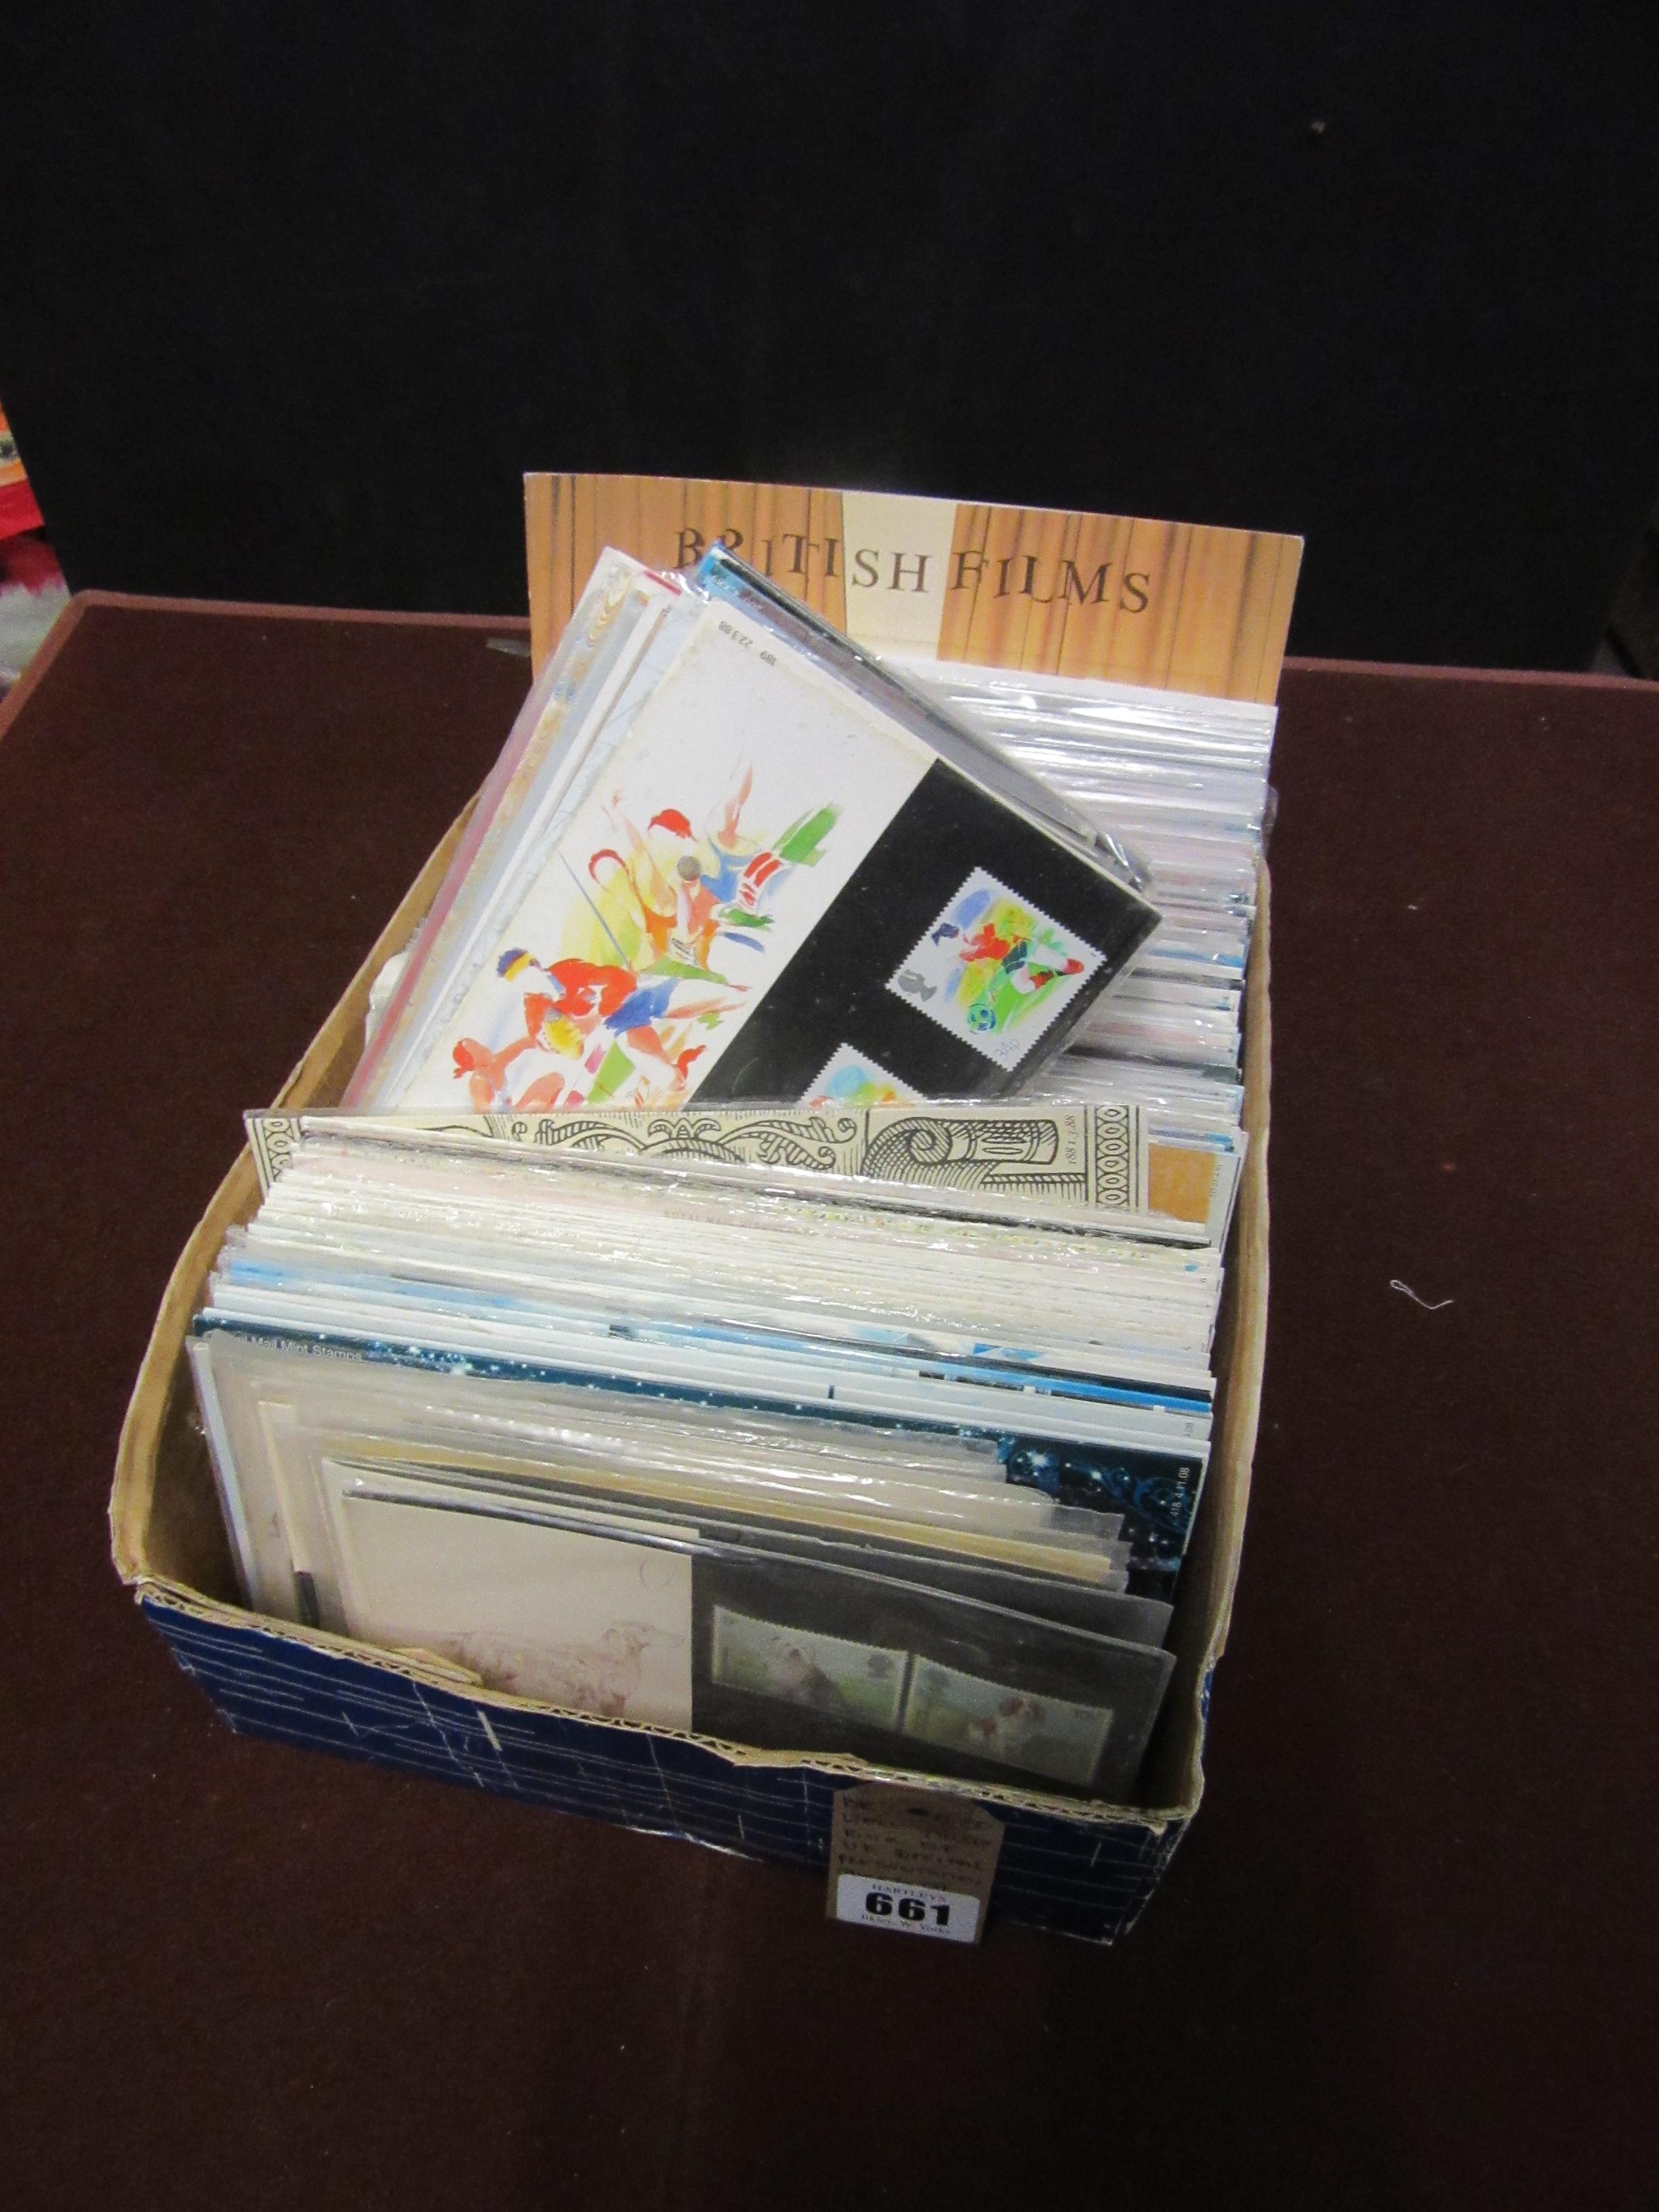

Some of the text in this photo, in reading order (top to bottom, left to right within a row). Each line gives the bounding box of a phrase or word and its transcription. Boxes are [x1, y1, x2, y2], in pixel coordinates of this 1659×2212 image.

[674, 527, 1150, 613] BRITISH FILMS
[1065, 1147, 1077, 1165] 188
[865, 1891, 950, 1926] 661
